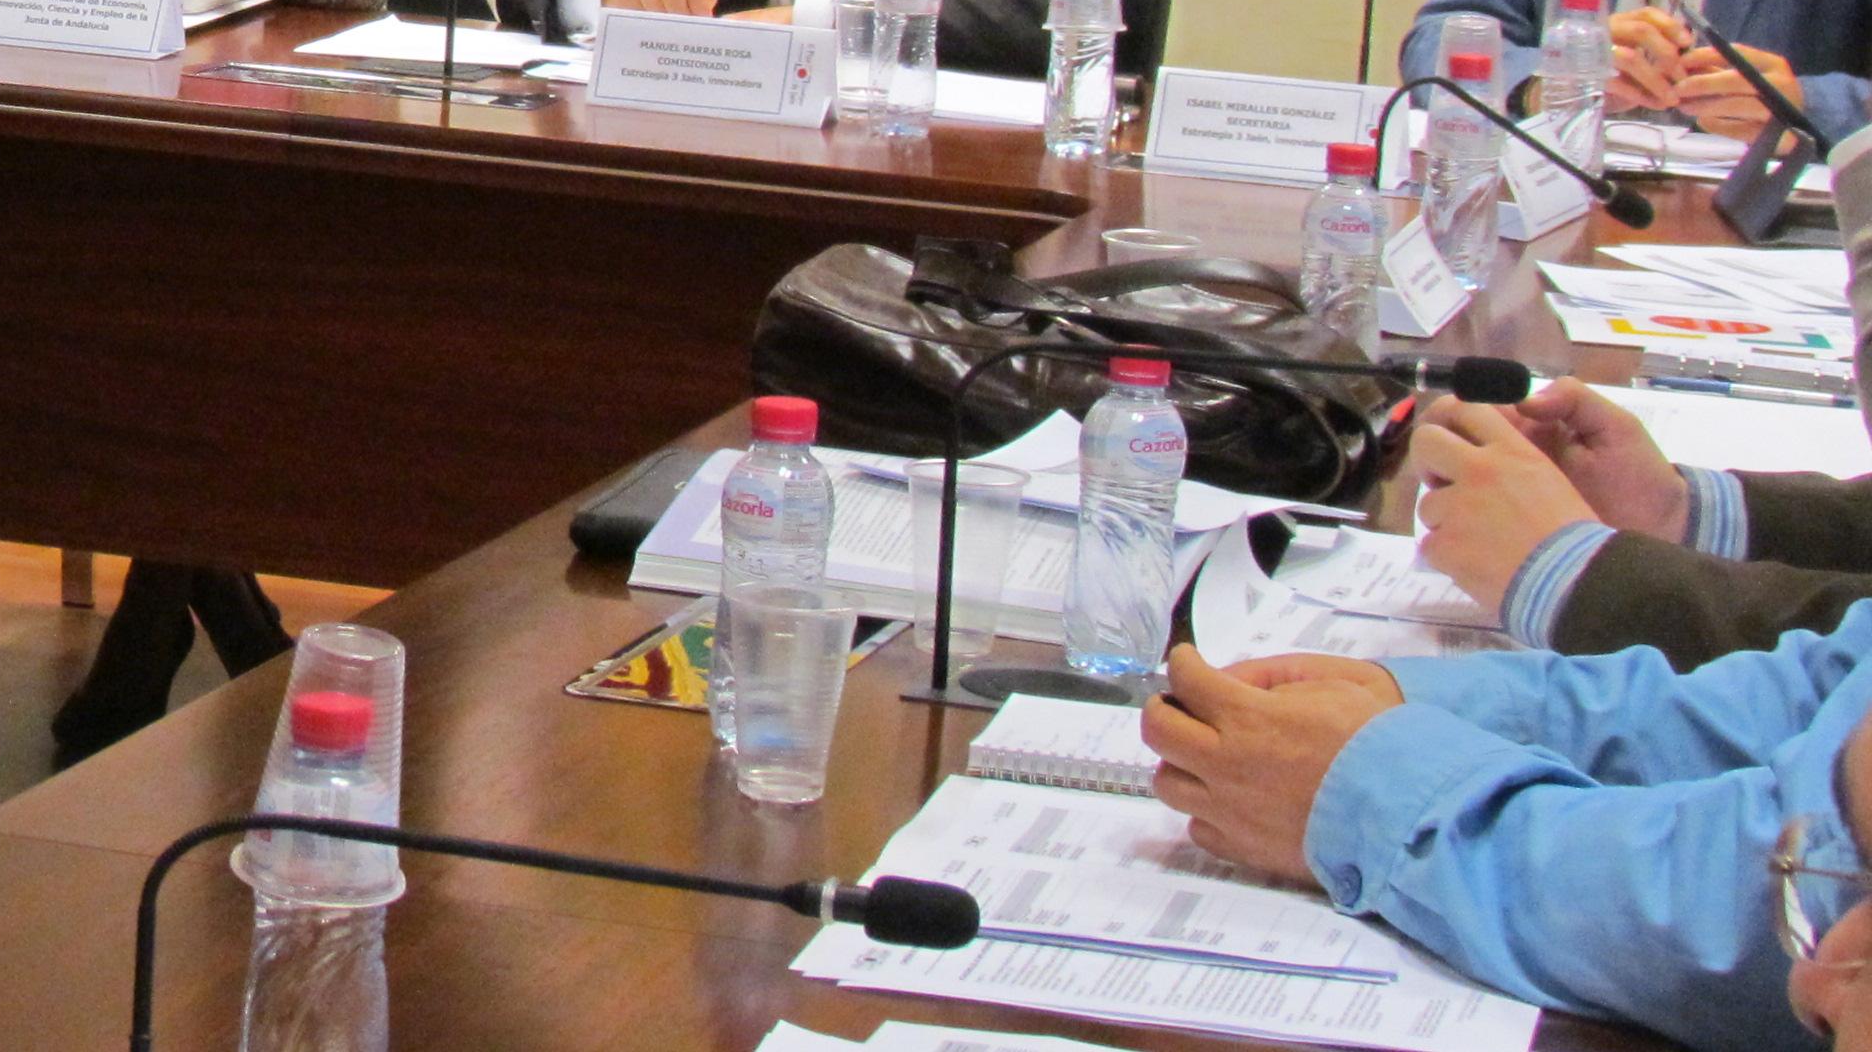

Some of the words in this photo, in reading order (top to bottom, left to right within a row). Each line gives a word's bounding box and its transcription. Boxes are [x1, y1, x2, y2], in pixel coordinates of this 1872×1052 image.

[47, 3, 80, 15] Ciencia
[82, 8, 89, 16] y
[90, 8, 124, 22] Empleo
[126, 10, 138, 21] de
[140, 11, 148, 22] la
[24, 15, 50, 27] Junta
[52, 16, 64, 27] de
[66, 17, 110, 31] Andalucía
[640, 40, 681, 54] MANUEL
[684, 44, 723, 58] PARRAS
[724, 47, 752, 59] ROSA
[657, 56, 731, 72] COMISIONADO
[621, 67, 670, 82] Estrategia
[671, 71, 678, 82] 3
[708, 76, 763, 90] innovadora
[1186, 98, 1224, 111] ISABEL
[1226, 101, 1278, 116] MIRALLES
[1226, 116, 1291, 131] SECRETARIA
[1181, 127, 1233, 142] Estrategia
[1274, 135, 1328, 148] innovador
